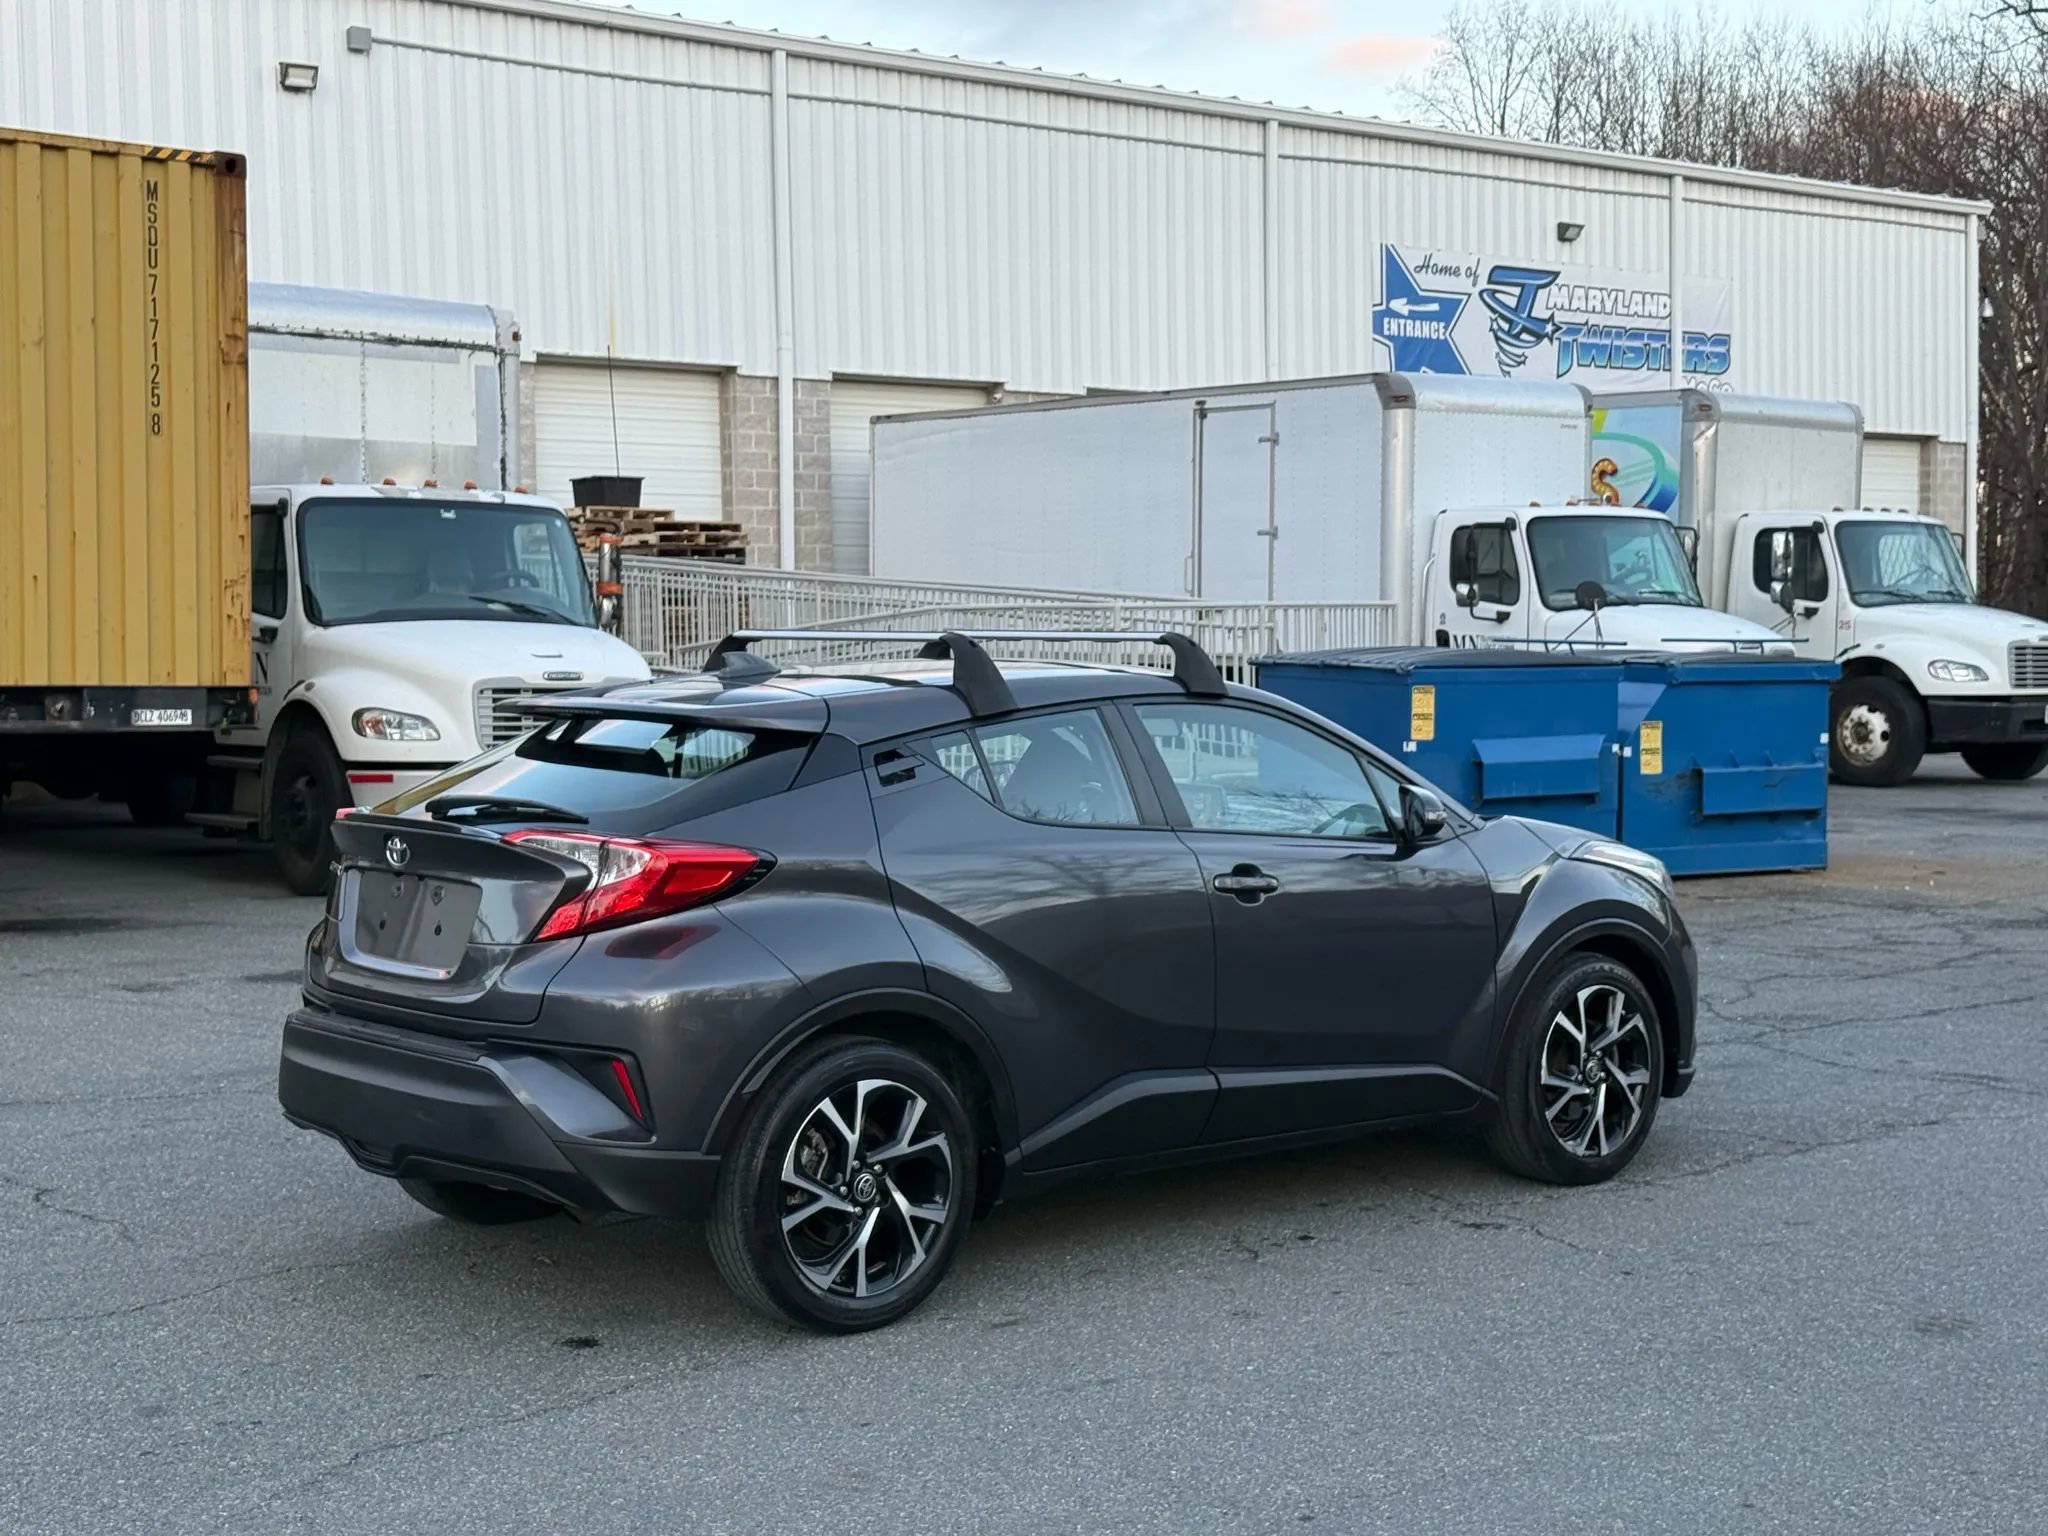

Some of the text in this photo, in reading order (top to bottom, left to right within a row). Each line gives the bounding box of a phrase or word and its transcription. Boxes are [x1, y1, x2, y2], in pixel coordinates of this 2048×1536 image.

[1413, 252, 1480, 287] Home of
[1545, 283, 1672, 319] MARYLAND
[1383, 317, 1446, 340] ENTRANCE
